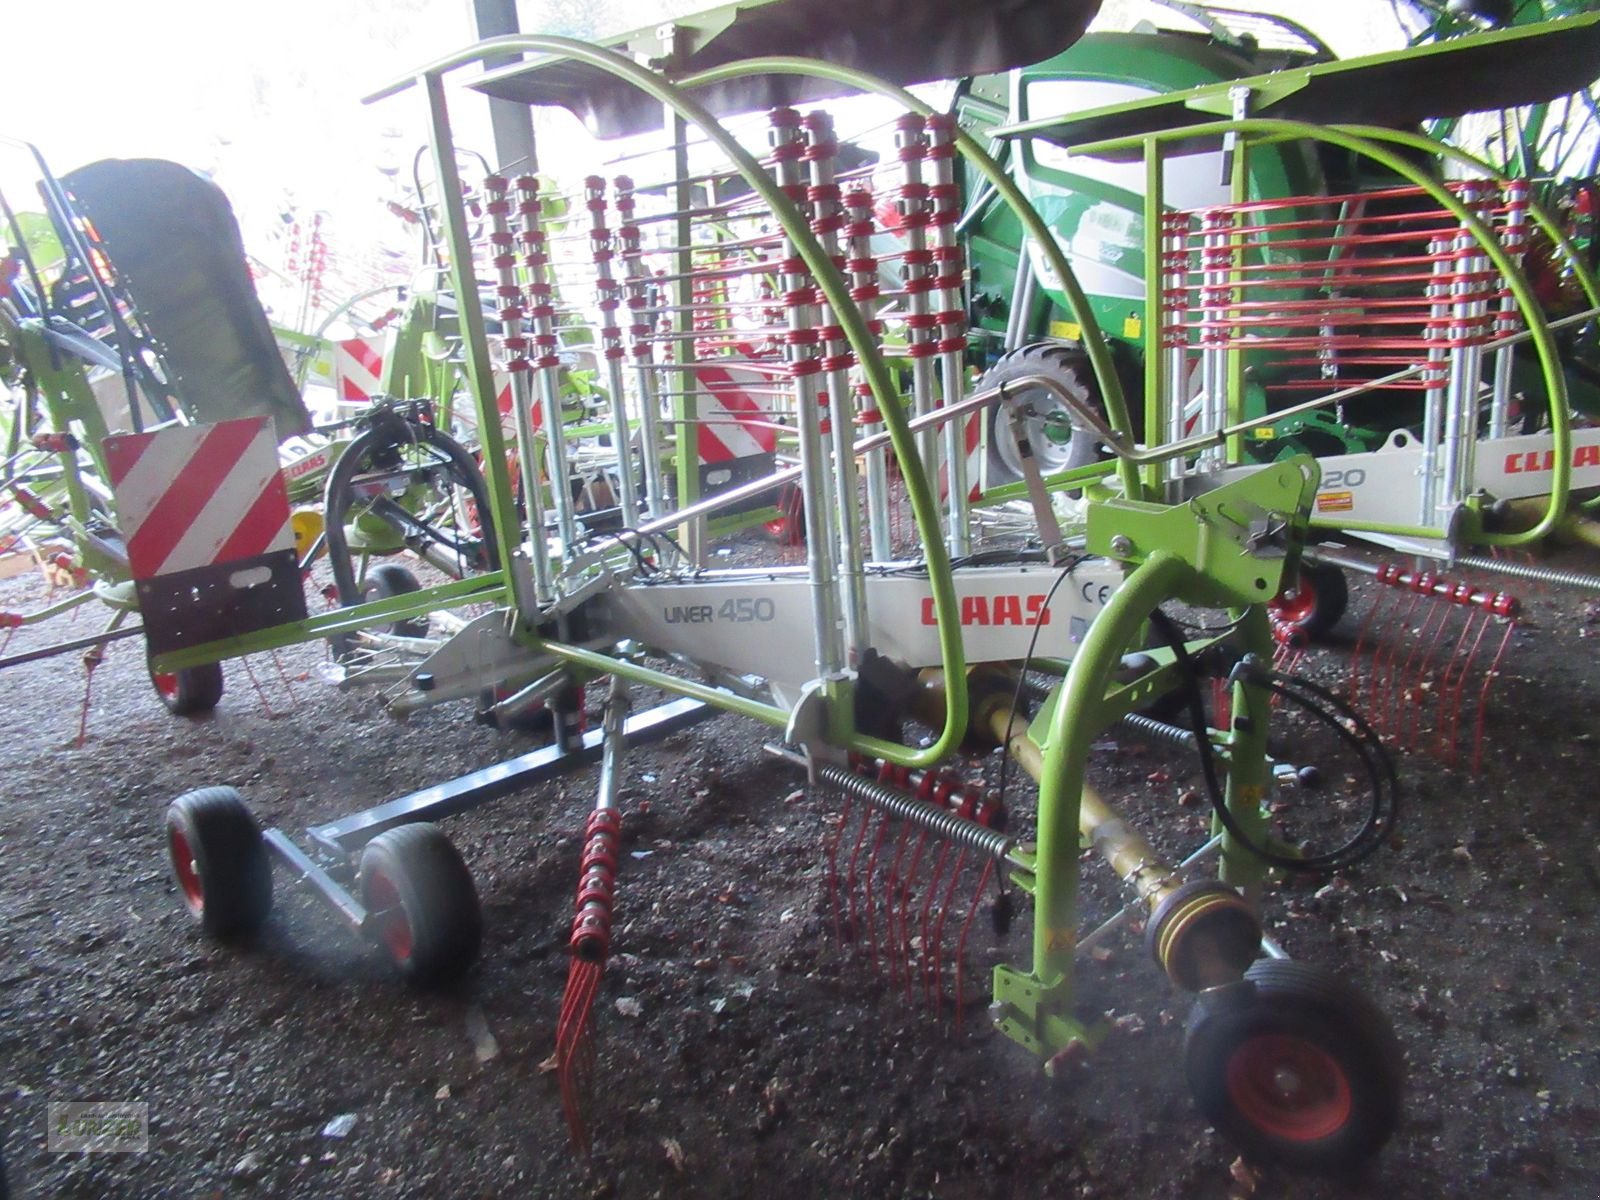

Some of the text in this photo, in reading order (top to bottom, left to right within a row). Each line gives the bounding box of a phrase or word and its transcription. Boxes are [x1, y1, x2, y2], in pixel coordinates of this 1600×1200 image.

[1318, 469, 1366, 489] 20
[664, 598, 775, 624] LINER 450
[921, 595, 1051, 626] CAAS
